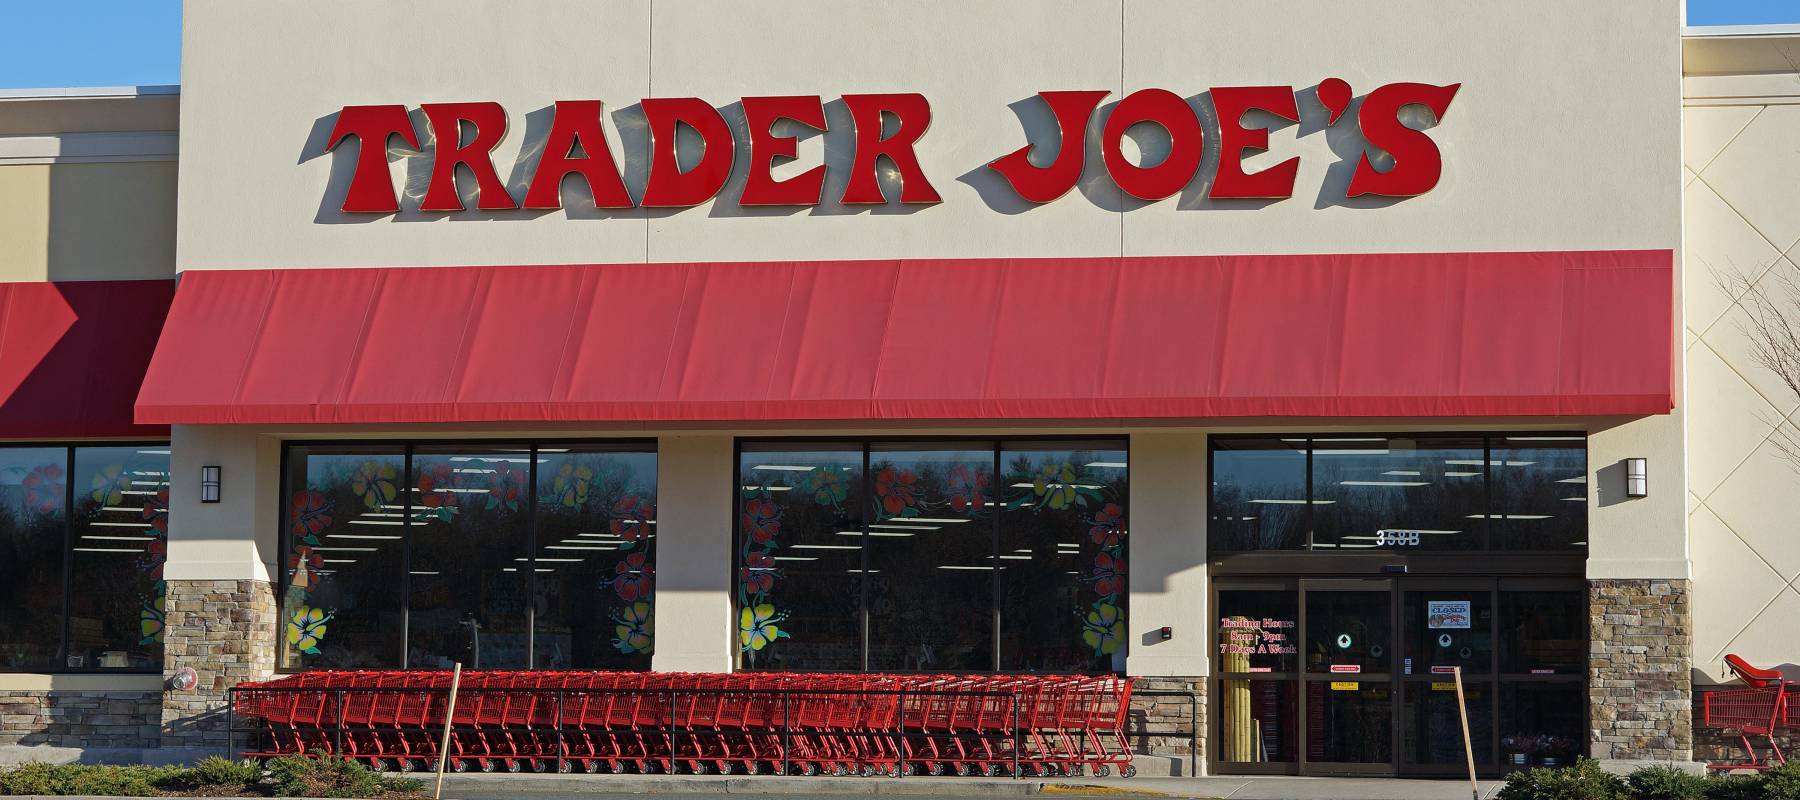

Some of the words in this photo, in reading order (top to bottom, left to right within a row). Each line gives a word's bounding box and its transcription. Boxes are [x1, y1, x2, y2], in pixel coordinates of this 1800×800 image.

[324, 93, 943, 212] TRADER
[987, 77, 1461, 204] JOE'S
[1376, 530, 1420, 545] 358B
[1221, 618, 1260, 629] Trading
[1263, 618, 1295, 628] Hours
[1230, 631, 1253, 640] 8am
[1263, 631, 1286, 643] 9pm
[1220, 644, 1227, 653] 7
[1230, 644, 1255, 655] Days
[1258, 644, 1267, 654] A
[1268, 644, 1297, 654] Week
